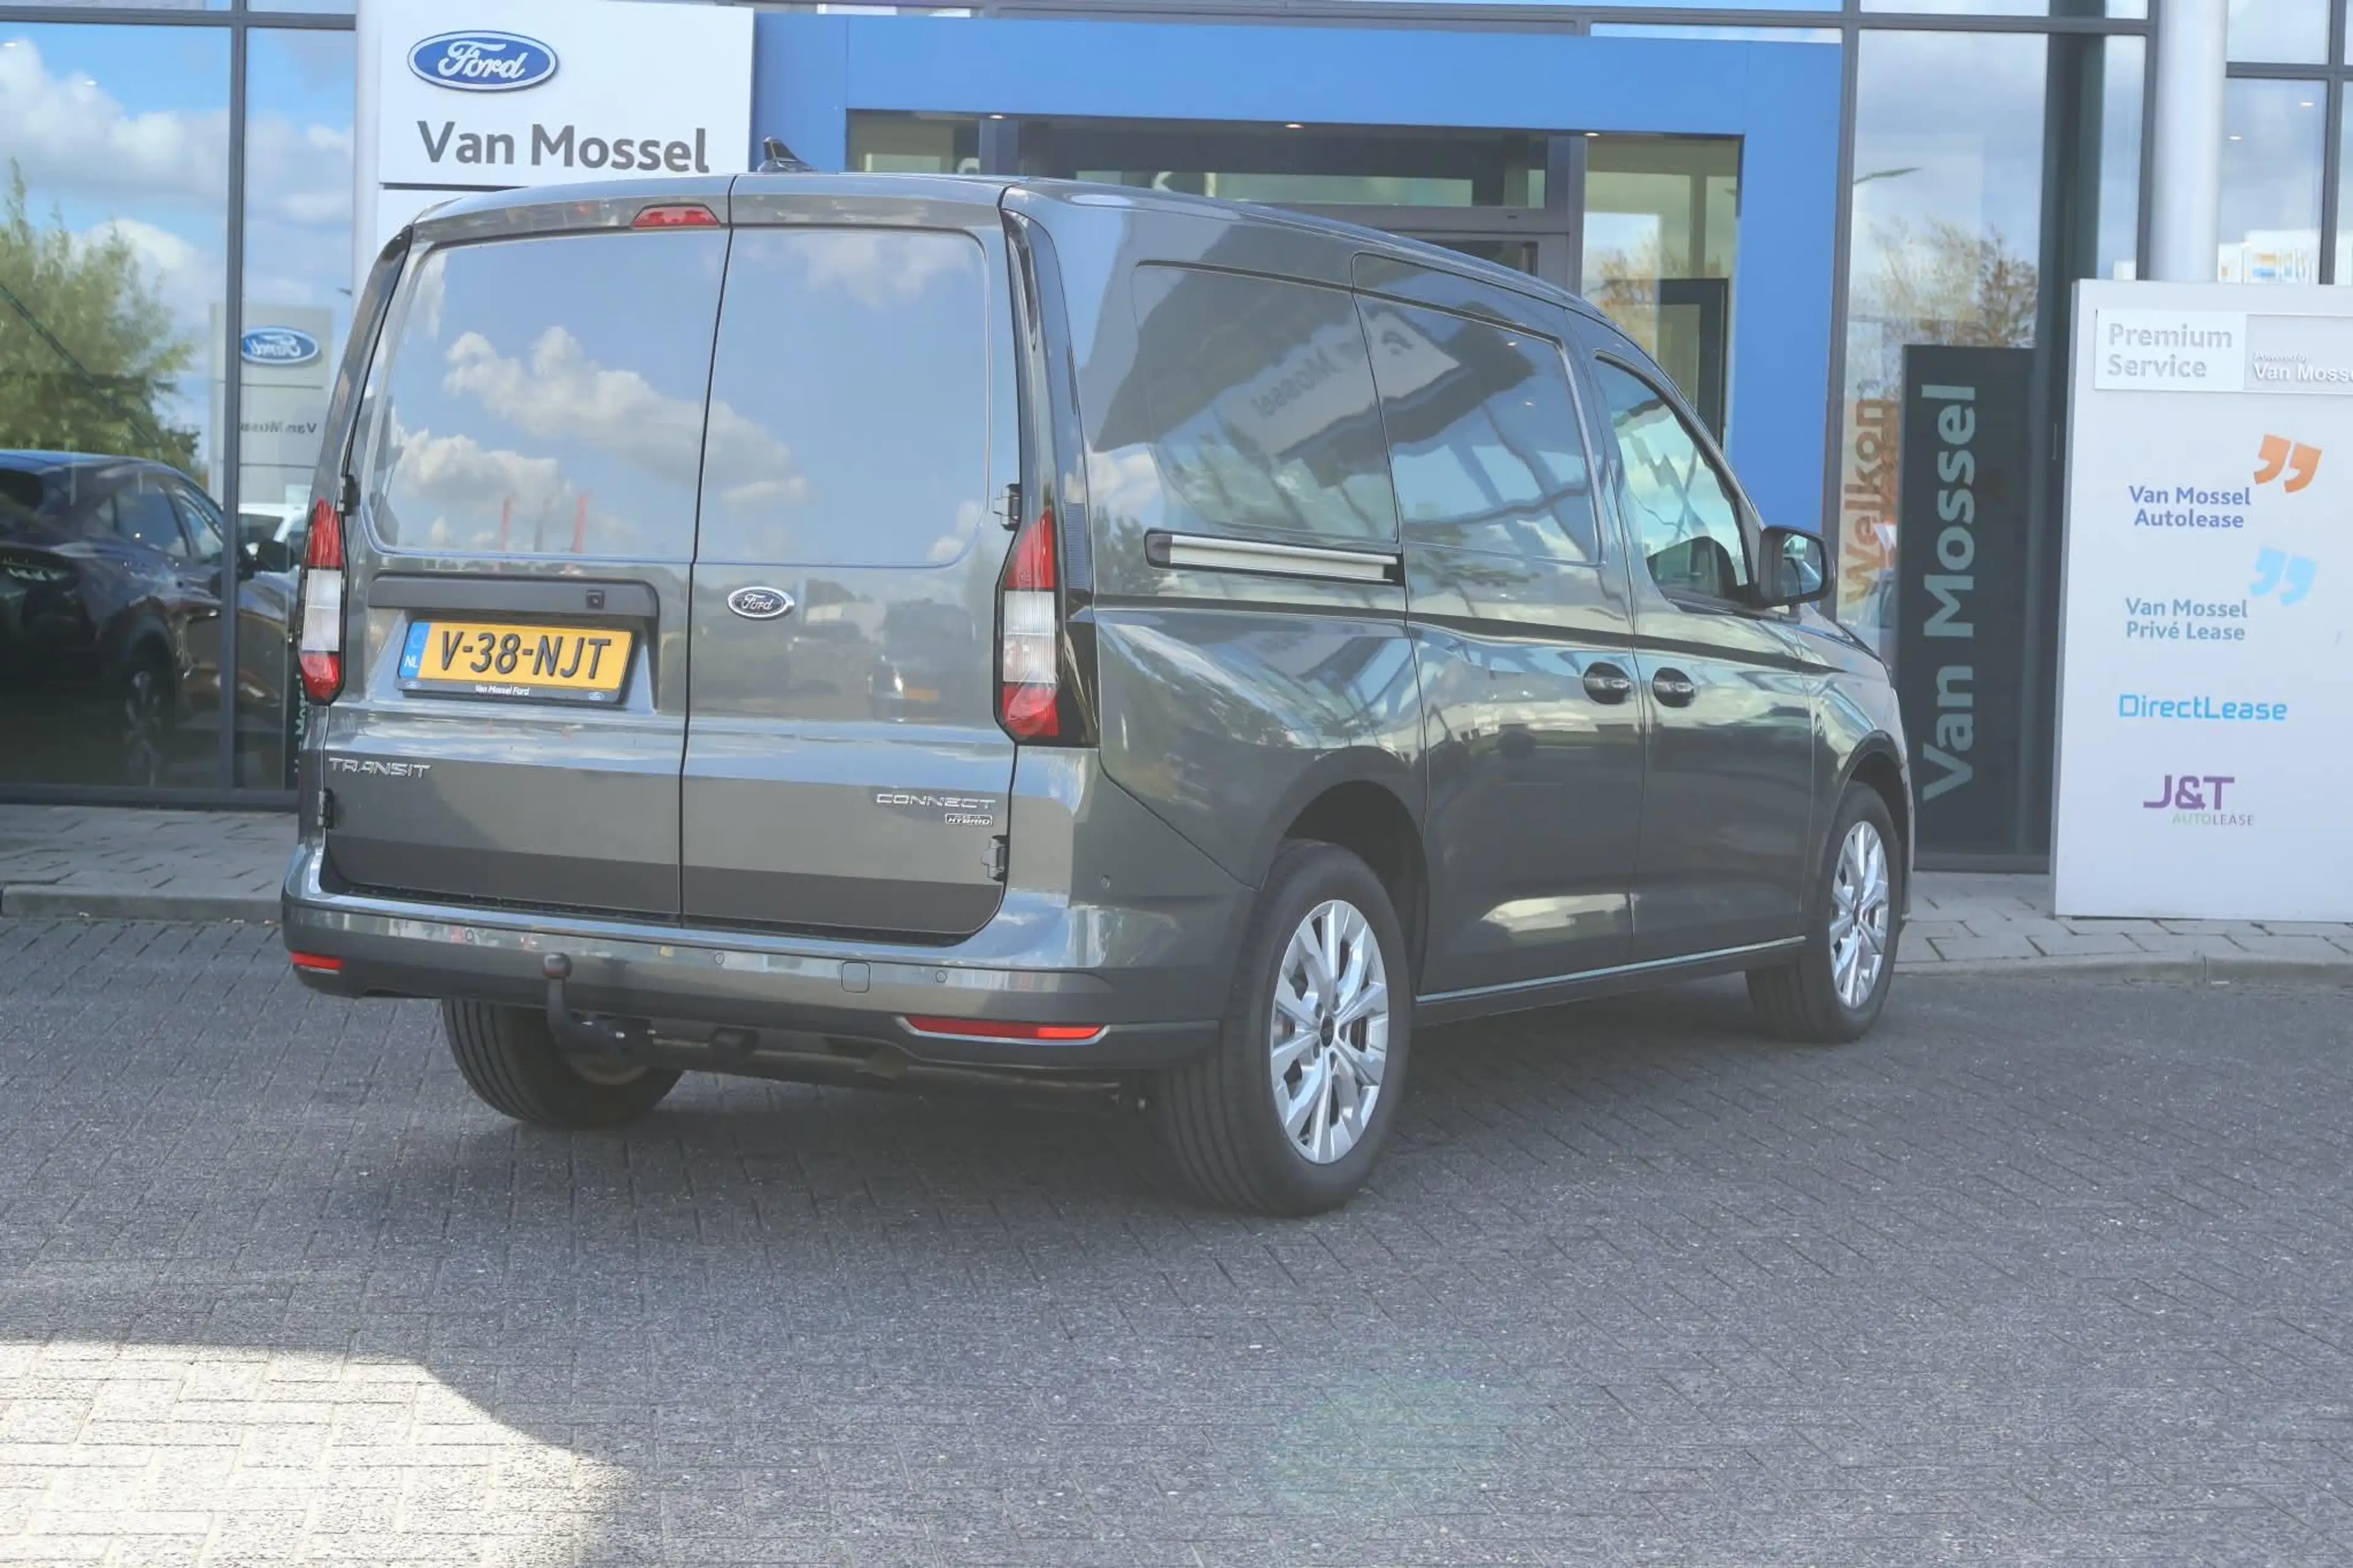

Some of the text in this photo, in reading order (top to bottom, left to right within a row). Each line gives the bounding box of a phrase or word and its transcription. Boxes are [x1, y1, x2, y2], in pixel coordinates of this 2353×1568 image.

[438, 40, 528, 78] Ford
[417, 121, 710, 173] Van Mossel
[2108, 322, 2233, 348] Premium
[2107, 354, 2207, 378] Service
[2253, 363, 2290, 381] Van
[2128, 486, 2251, 506] Van Mossel
[2134, 509, 2245, 528] Autolease
[741, 593, 775, 610] Ford
[1921, 384, 1977, 801] Van Mossel
[2125, 597, 2248, 618] Van Mossel
[2126, 620, 2246, 641] Privé Lease
[404, 655, 419, 668] NL
[441, 631, 612, 680] V-38-NJT
[2119, 694, 2288, 721] DirectLease
[328, 757, 431, 779] TRANSIT
[876, 793, 996, 809] CONNECT
[2143, 775, 2235, 810] J&T
[2172, 812, 2255, 827] AUTOLEASE
